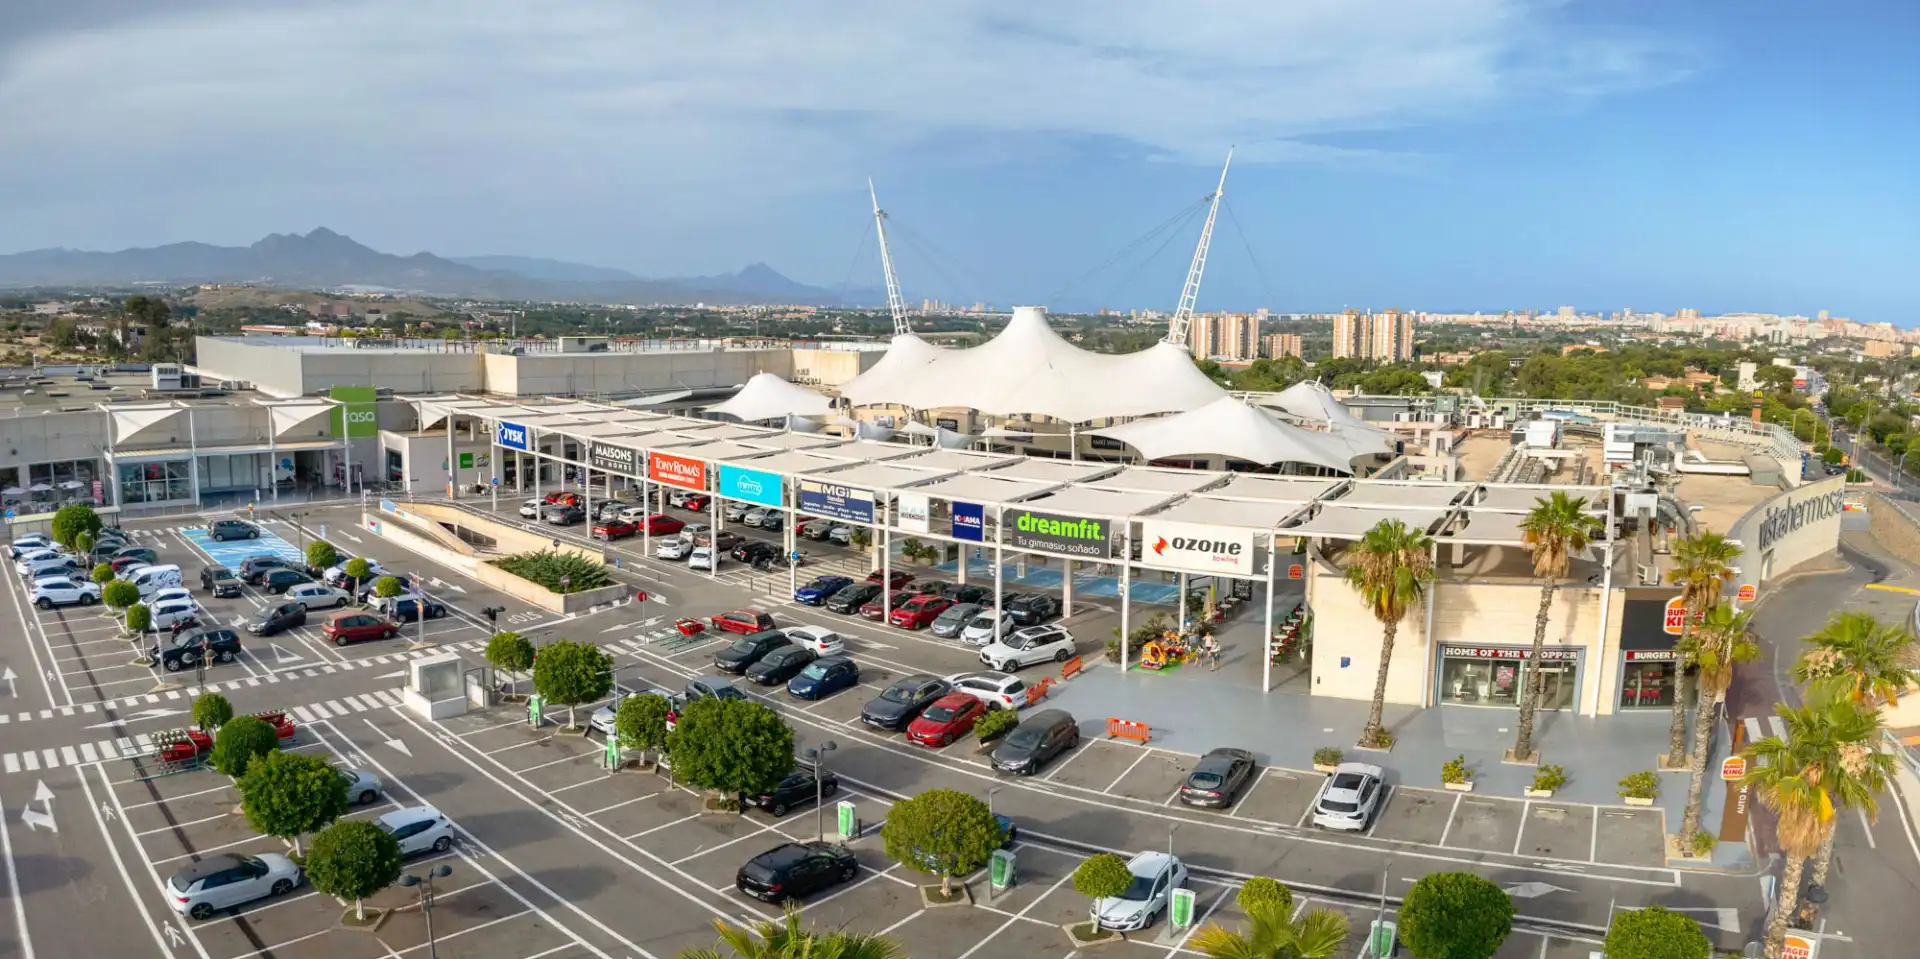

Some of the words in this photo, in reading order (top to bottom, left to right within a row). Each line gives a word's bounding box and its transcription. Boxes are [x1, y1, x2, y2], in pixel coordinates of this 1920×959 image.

[504, 428, 524, 444] JYSK
[595, 445, 632, 462] MAISONS
[1758, 487, 1844, 551] vistahermosa
[1017, 535, 1027, 546] Tu
[1028, 539, 1066, 551] gimnasio
[1067, 543, 1100, 555] soñado
[1172, 536, 1242, 556] ozone
[1212, 554, 1239, 565] bowling
[1445, 647, 1477, 657] HOME
[1479, 648, 1495, 658] OF
[1497, 650, 1520, 659] THE
[1522, 650, 1577, 660] WOPPER
[1633, 651, 1670, 660] BURGER
[1736, 794, 1747, 815] AUTO
